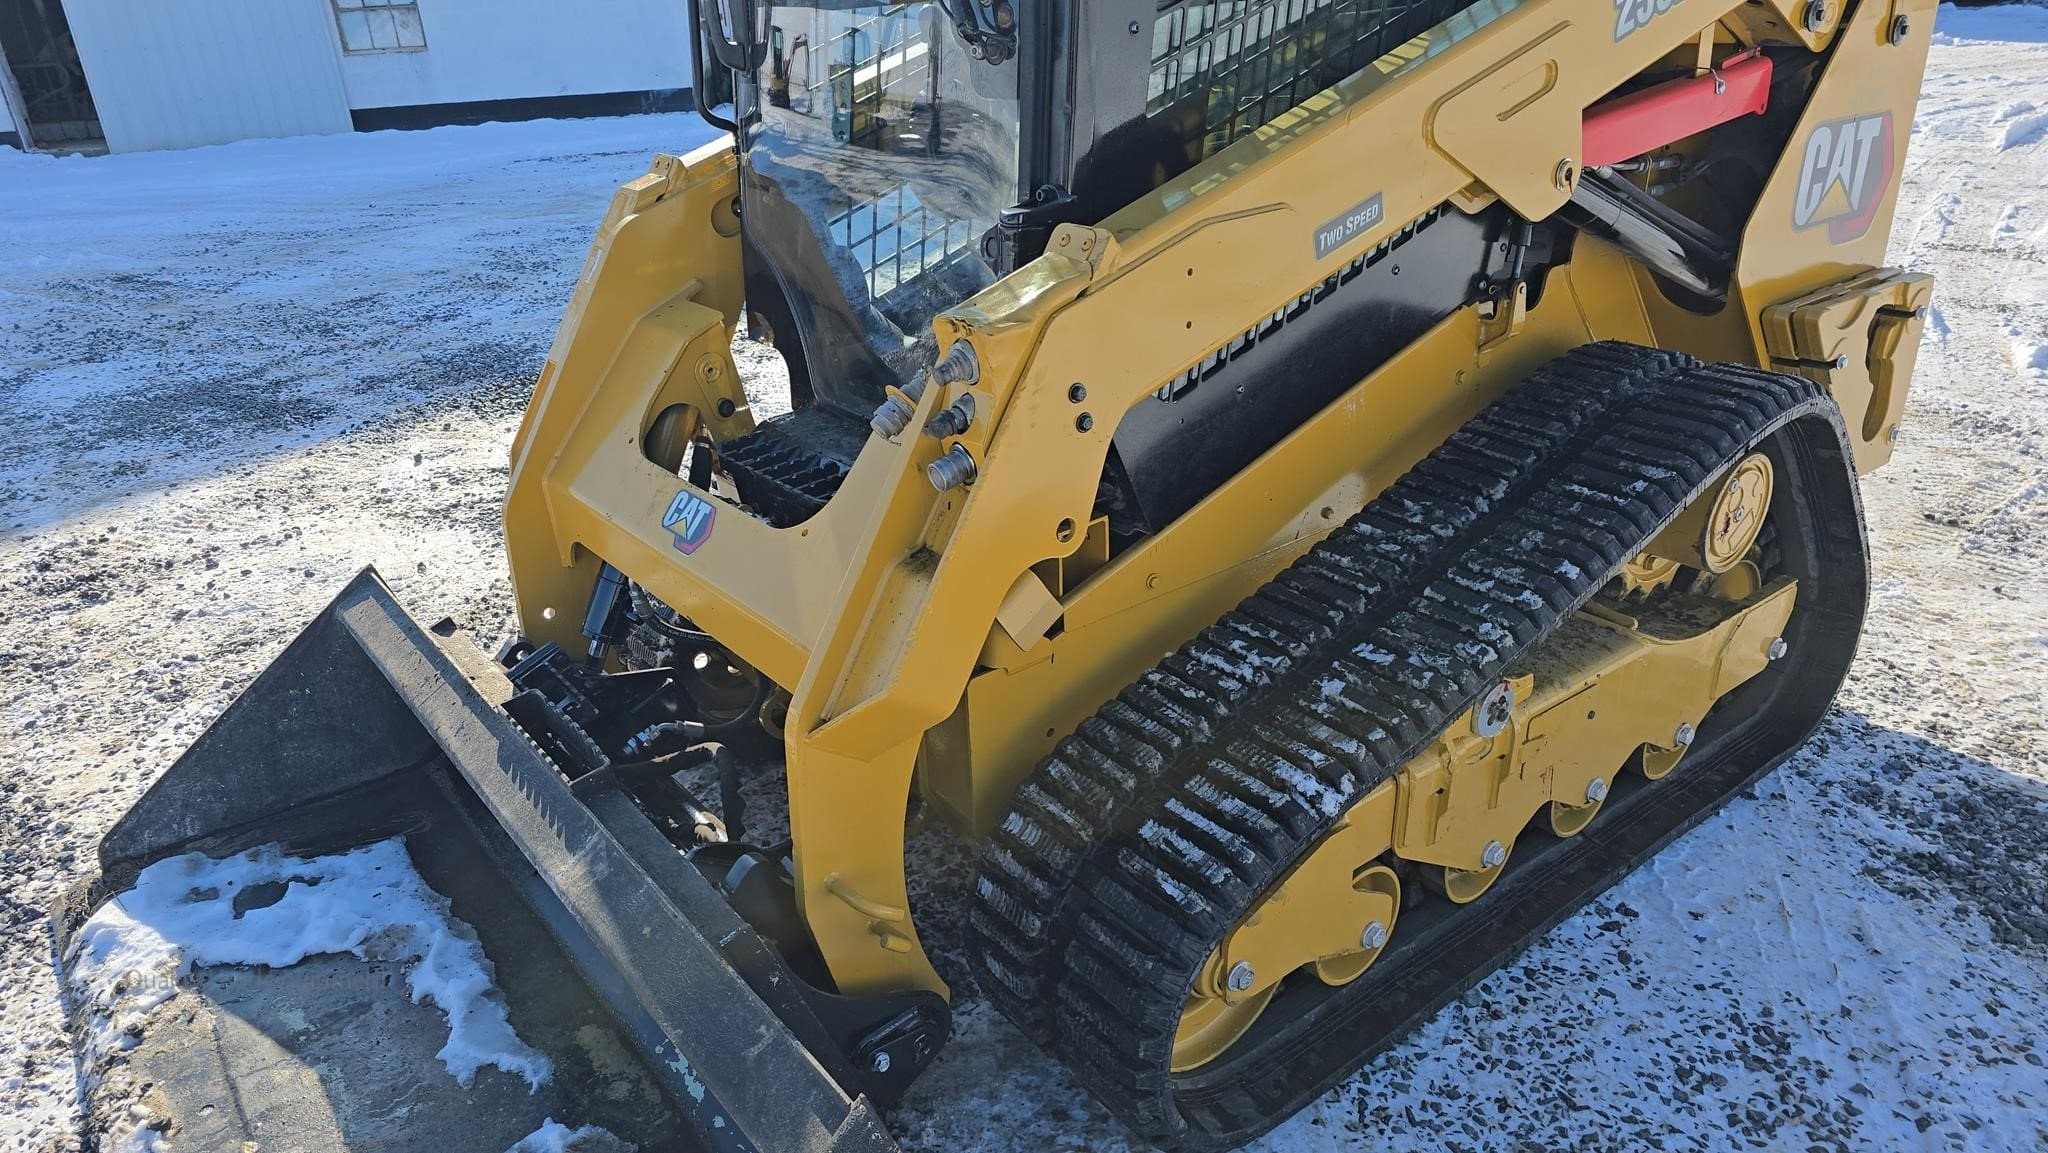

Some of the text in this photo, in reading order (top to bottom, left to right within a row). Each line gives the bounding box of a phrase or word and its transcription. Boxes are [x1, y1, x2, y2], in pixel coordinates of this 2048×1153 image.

[1794, 115, 1883, 227] CAT
[1319, 203, 1379, 252] TWO SPEED
[662, 490, 714, 541] CAT
